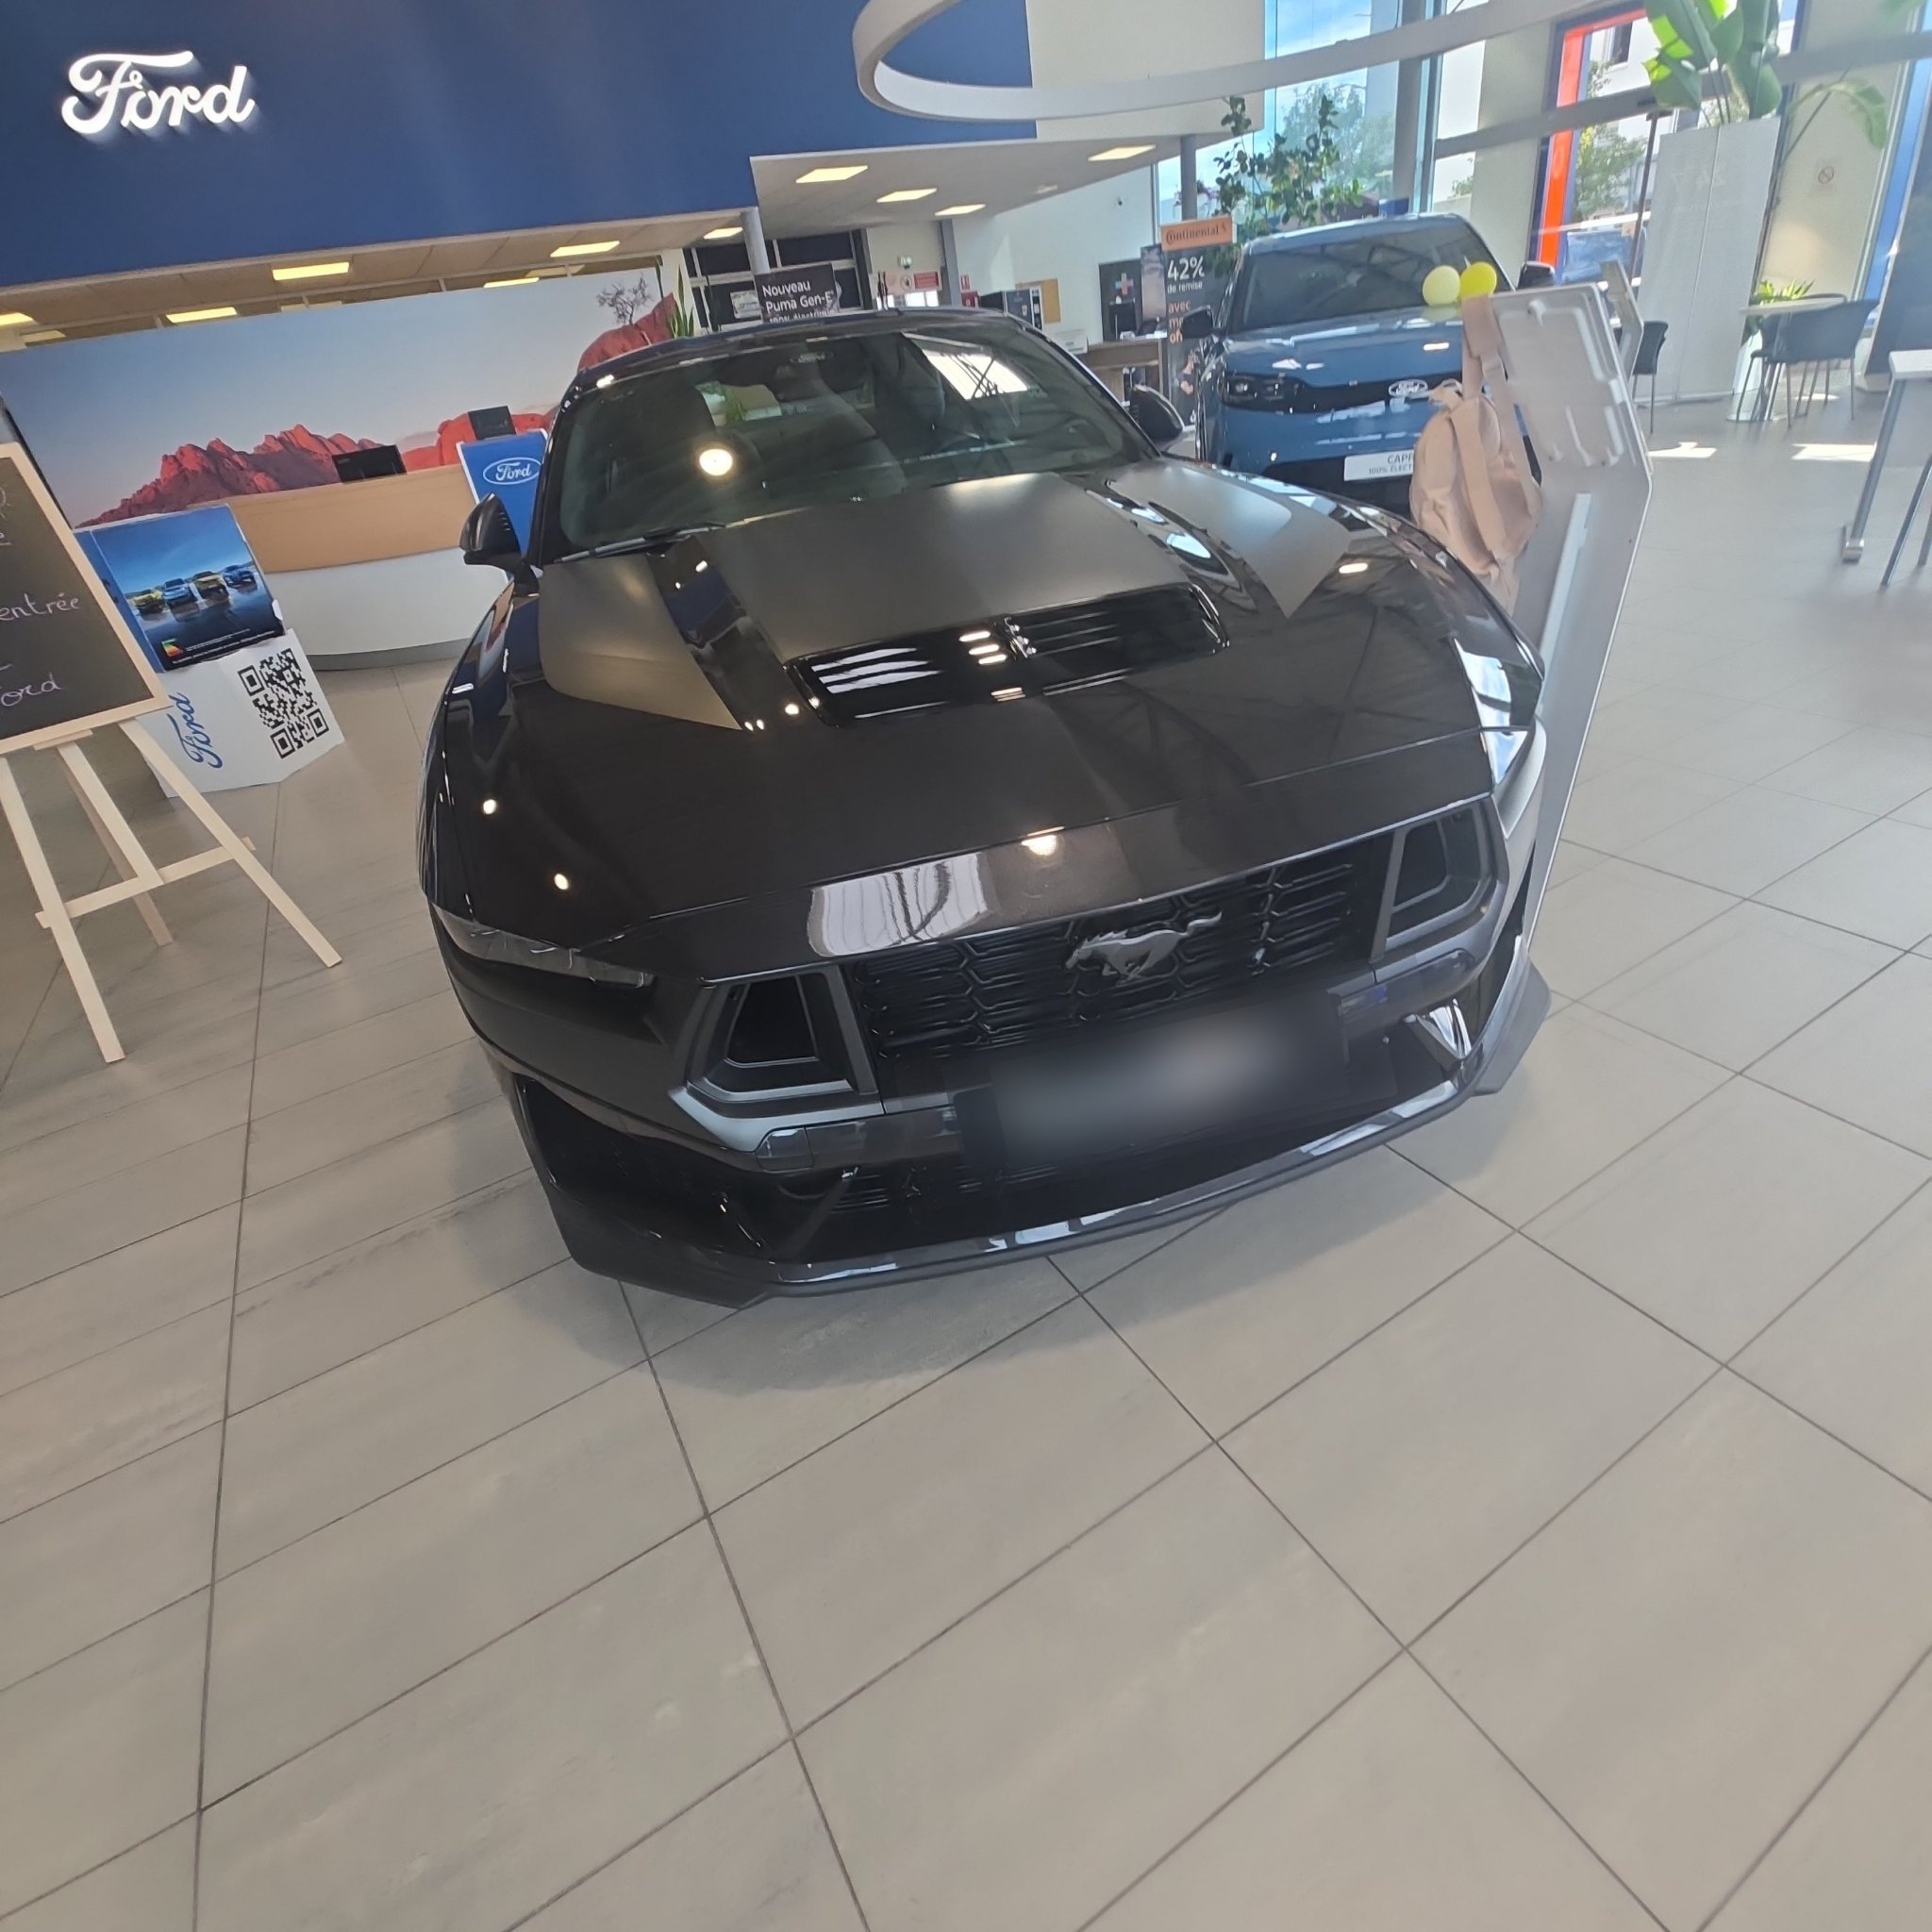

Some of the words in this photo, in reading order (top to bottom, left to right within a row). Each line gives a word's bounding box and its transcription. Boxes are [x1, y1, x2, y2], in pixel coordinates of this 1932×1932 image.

[61, 51, 255, 134] Ford
[1166, 225, 1219, 244] Continental
[1167, 256, 1205, 282] 42%
[762, 280, 811, 297] Nouveau
[1167, 285, 1176, 294] de
[1178, 282, 1203, 292] remise
[766, 299, 798, 314] Puma
[495, 461, 532, 481] Ford
[0, 671, 62, 707] ord
[167, 692, 223, 769] Ford
